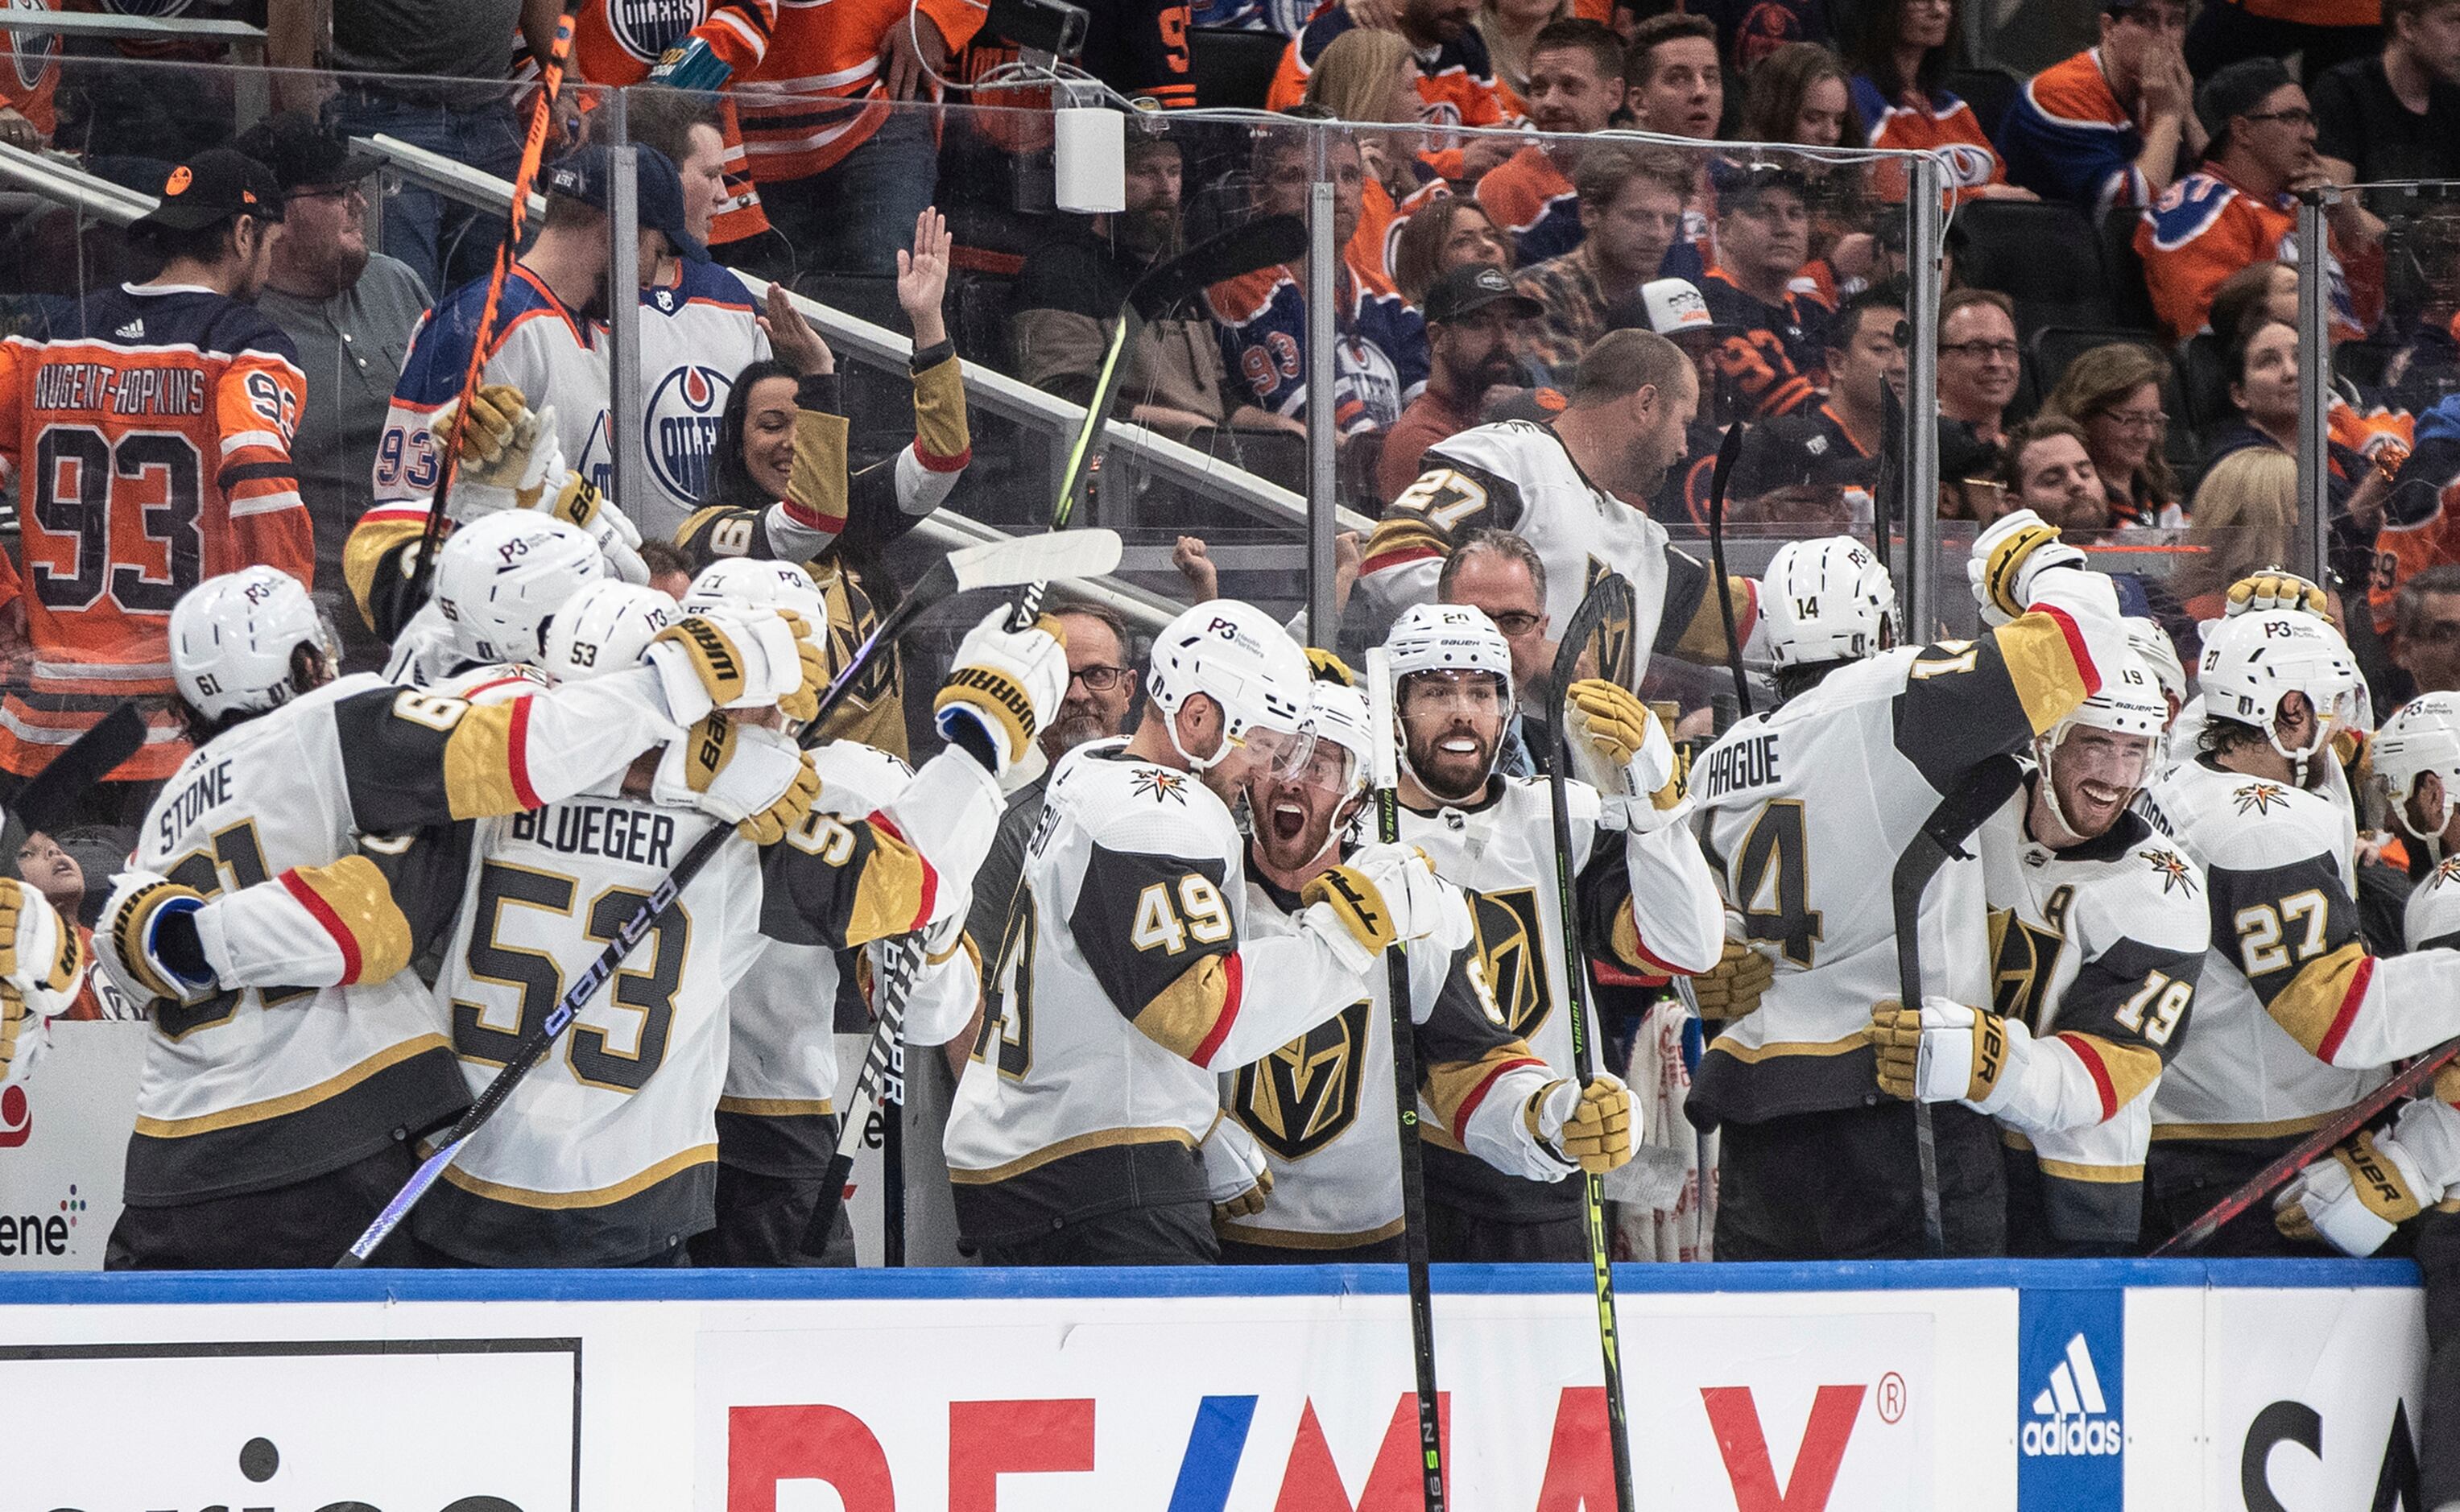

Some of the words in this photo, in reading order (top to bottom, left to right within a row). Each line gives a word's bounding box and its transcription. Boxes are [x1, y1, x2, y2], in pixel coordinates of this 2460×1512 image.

[1158, 5, 1192, 73] 9
[1241, 331, 1300, 396] 93
[35, 364, 205, 415] NUGENT-HOPKINS
[244, 370, 300, 451] 93
[378, 426, 442, 488] 93
[31, 423, 206, 613] 93
[1394, 468, 1488, 533] 27
[498, 538, 528, 564] P3
[1847, 548, 1868, 570] P3
[778, 570, 803, 589] P3
[644, 608, 668, 633] P3
[1207, 617, 1238, 640] P3
[1796, 596, 1819, 620] 14
[2264, 621, 2293, 638] P3
[569, 641, 597, 668] 53
[2122, 669, 2144, 685] 19
[2203, 650, 2221, 671] 27
[195, 673, 223, 696] 61
[945, 667, 1036, 740] WARRIO
[2115, 701, 2152, 713] BAUER
[2401, 700, 2424, 721] P3
[1706, 734, 1782, 800] HAGUE
[159, 759, 234, 853] STONE
[511, 804, 676, 869] BLUEGER
[1734, 797, 1824, 970] 4
[1130, 873, 1233, 956] 49
[2043, 884, 2076, 935] A
[2235, 888, 2330, 977] 27
[451, 858, 693, 1095] 53
[2113, 969, 2194, 1047] 19
[1978, 1012, 2002, 1084] UER
[0, 1214, 70, 1257] ene
[2022, 1414, 2122, 1456] adidas
